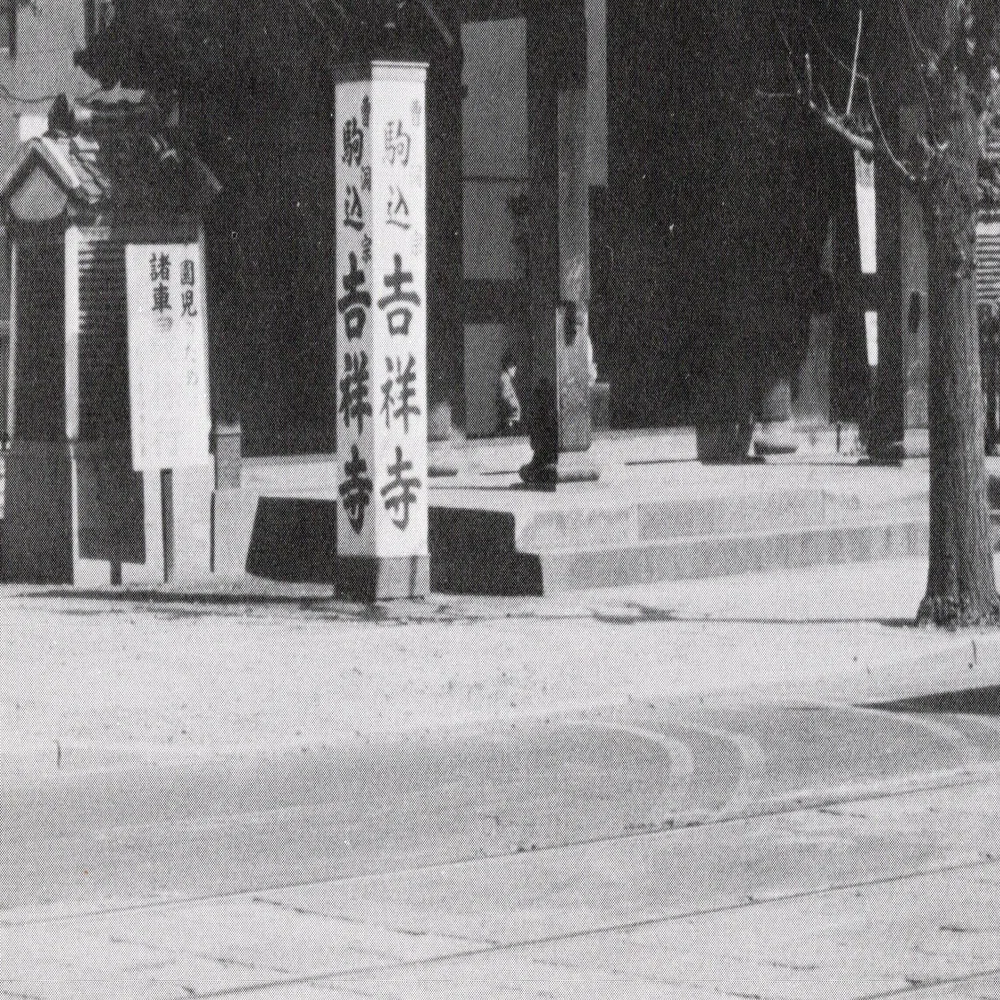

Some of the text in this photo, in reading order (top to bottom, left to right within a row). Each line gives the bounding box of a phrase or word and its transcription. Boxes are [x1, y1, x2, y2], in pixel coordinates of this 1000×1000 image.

[377, 119, 421, 531] 駒込吉祥寺
